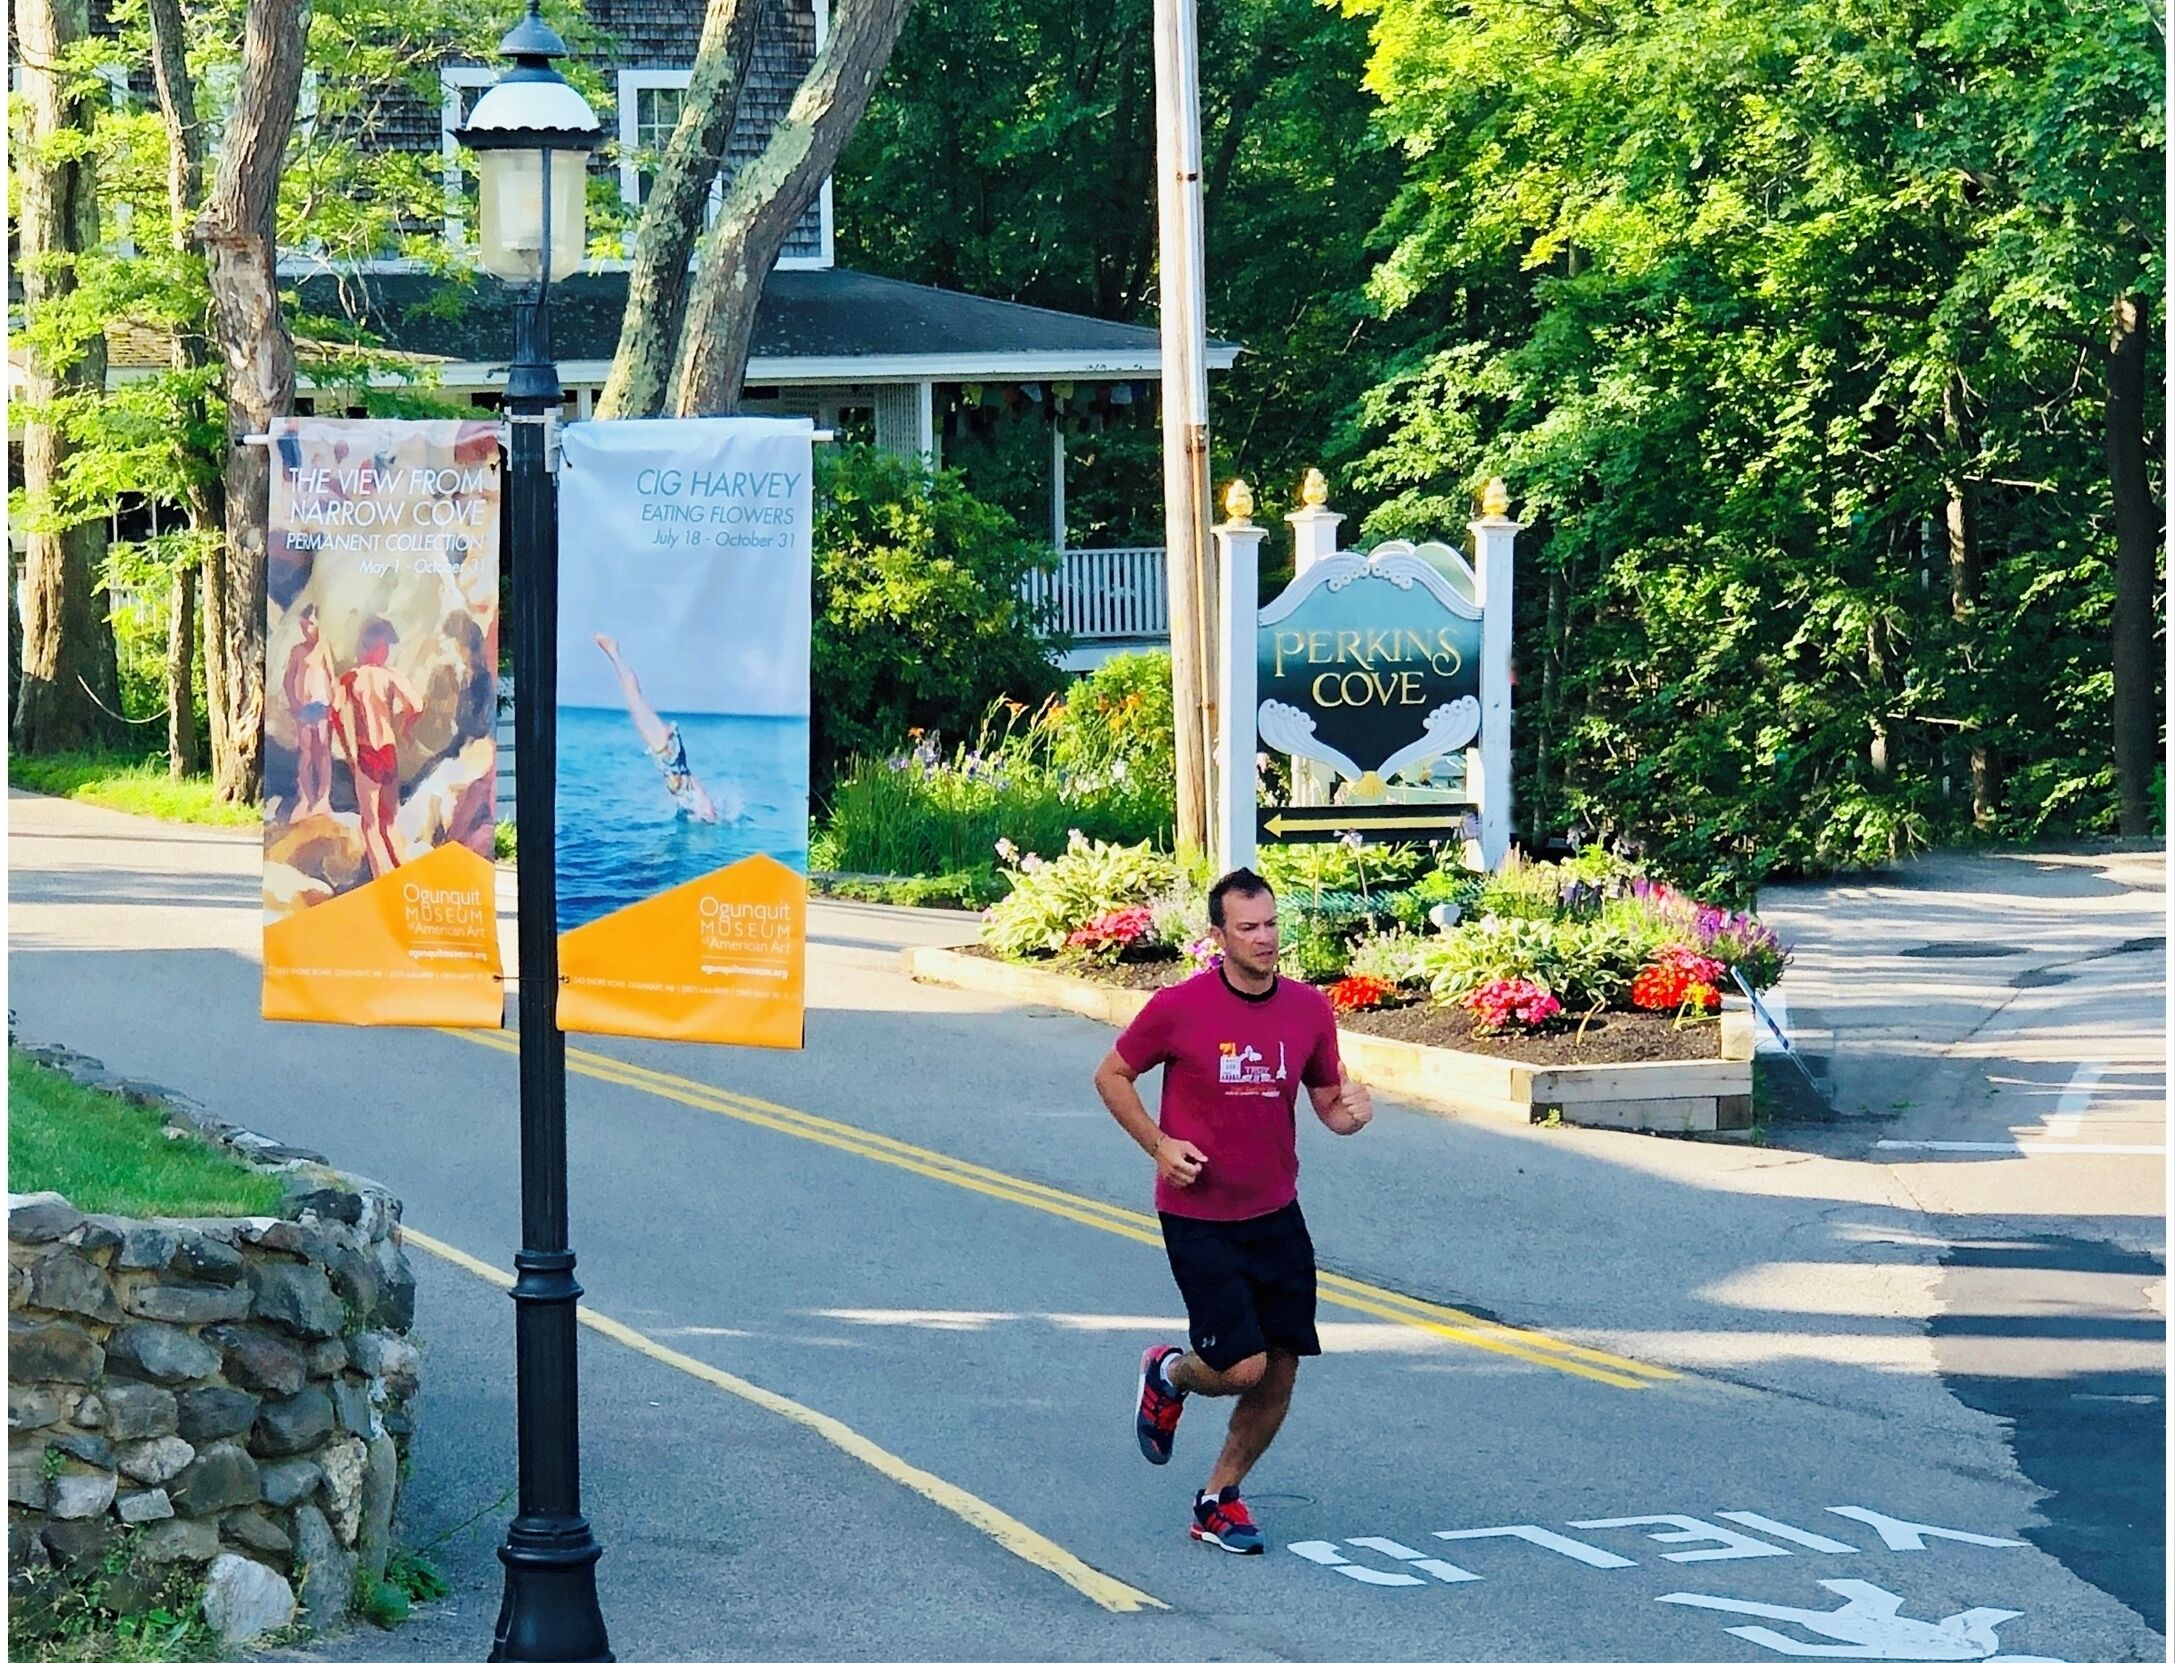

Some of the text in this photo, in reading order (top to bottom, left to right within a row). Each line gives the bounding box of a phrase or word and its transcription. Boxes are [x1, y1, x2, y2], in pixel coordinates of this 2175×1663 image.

[289, 468, 484, 495] THE VIEW FROM
[637, 469, 802, 499] CIG HARVEY
[290, 500, 487, 527] NARROW COVE
[641, 504, 795, 525] EATING FLOWERS
[286, 532, 484, 553] PERMANENT COLLECTION
[652, 528, 679, 549] July
[685, 530, 701, 546] 18
[715, 530, 774, 548] October
[778, 533, 795, 549] 31
[361, 559, 387, 578] May
[395, 559, 400, 573] 1
[415, 559, 463, 574] October
[1274, 627, 1461, 677] PERKINS
[1312, 671, 1427, 708] COVE
[403, 883, 482, 909] Ogunquit
[405, 906, 483, 924] MUSEUM
[699, 896, 790, 924] Ogunquit
[415, 923, 465, 937] American
[466, 926, 485, 938] Art
[700, 920, 790, 939] MUSEUM
[709, 937, 768, 952] American
[770, 941, 790, 954] Art
[1287, 1505, 2033, 1586] YIELD
